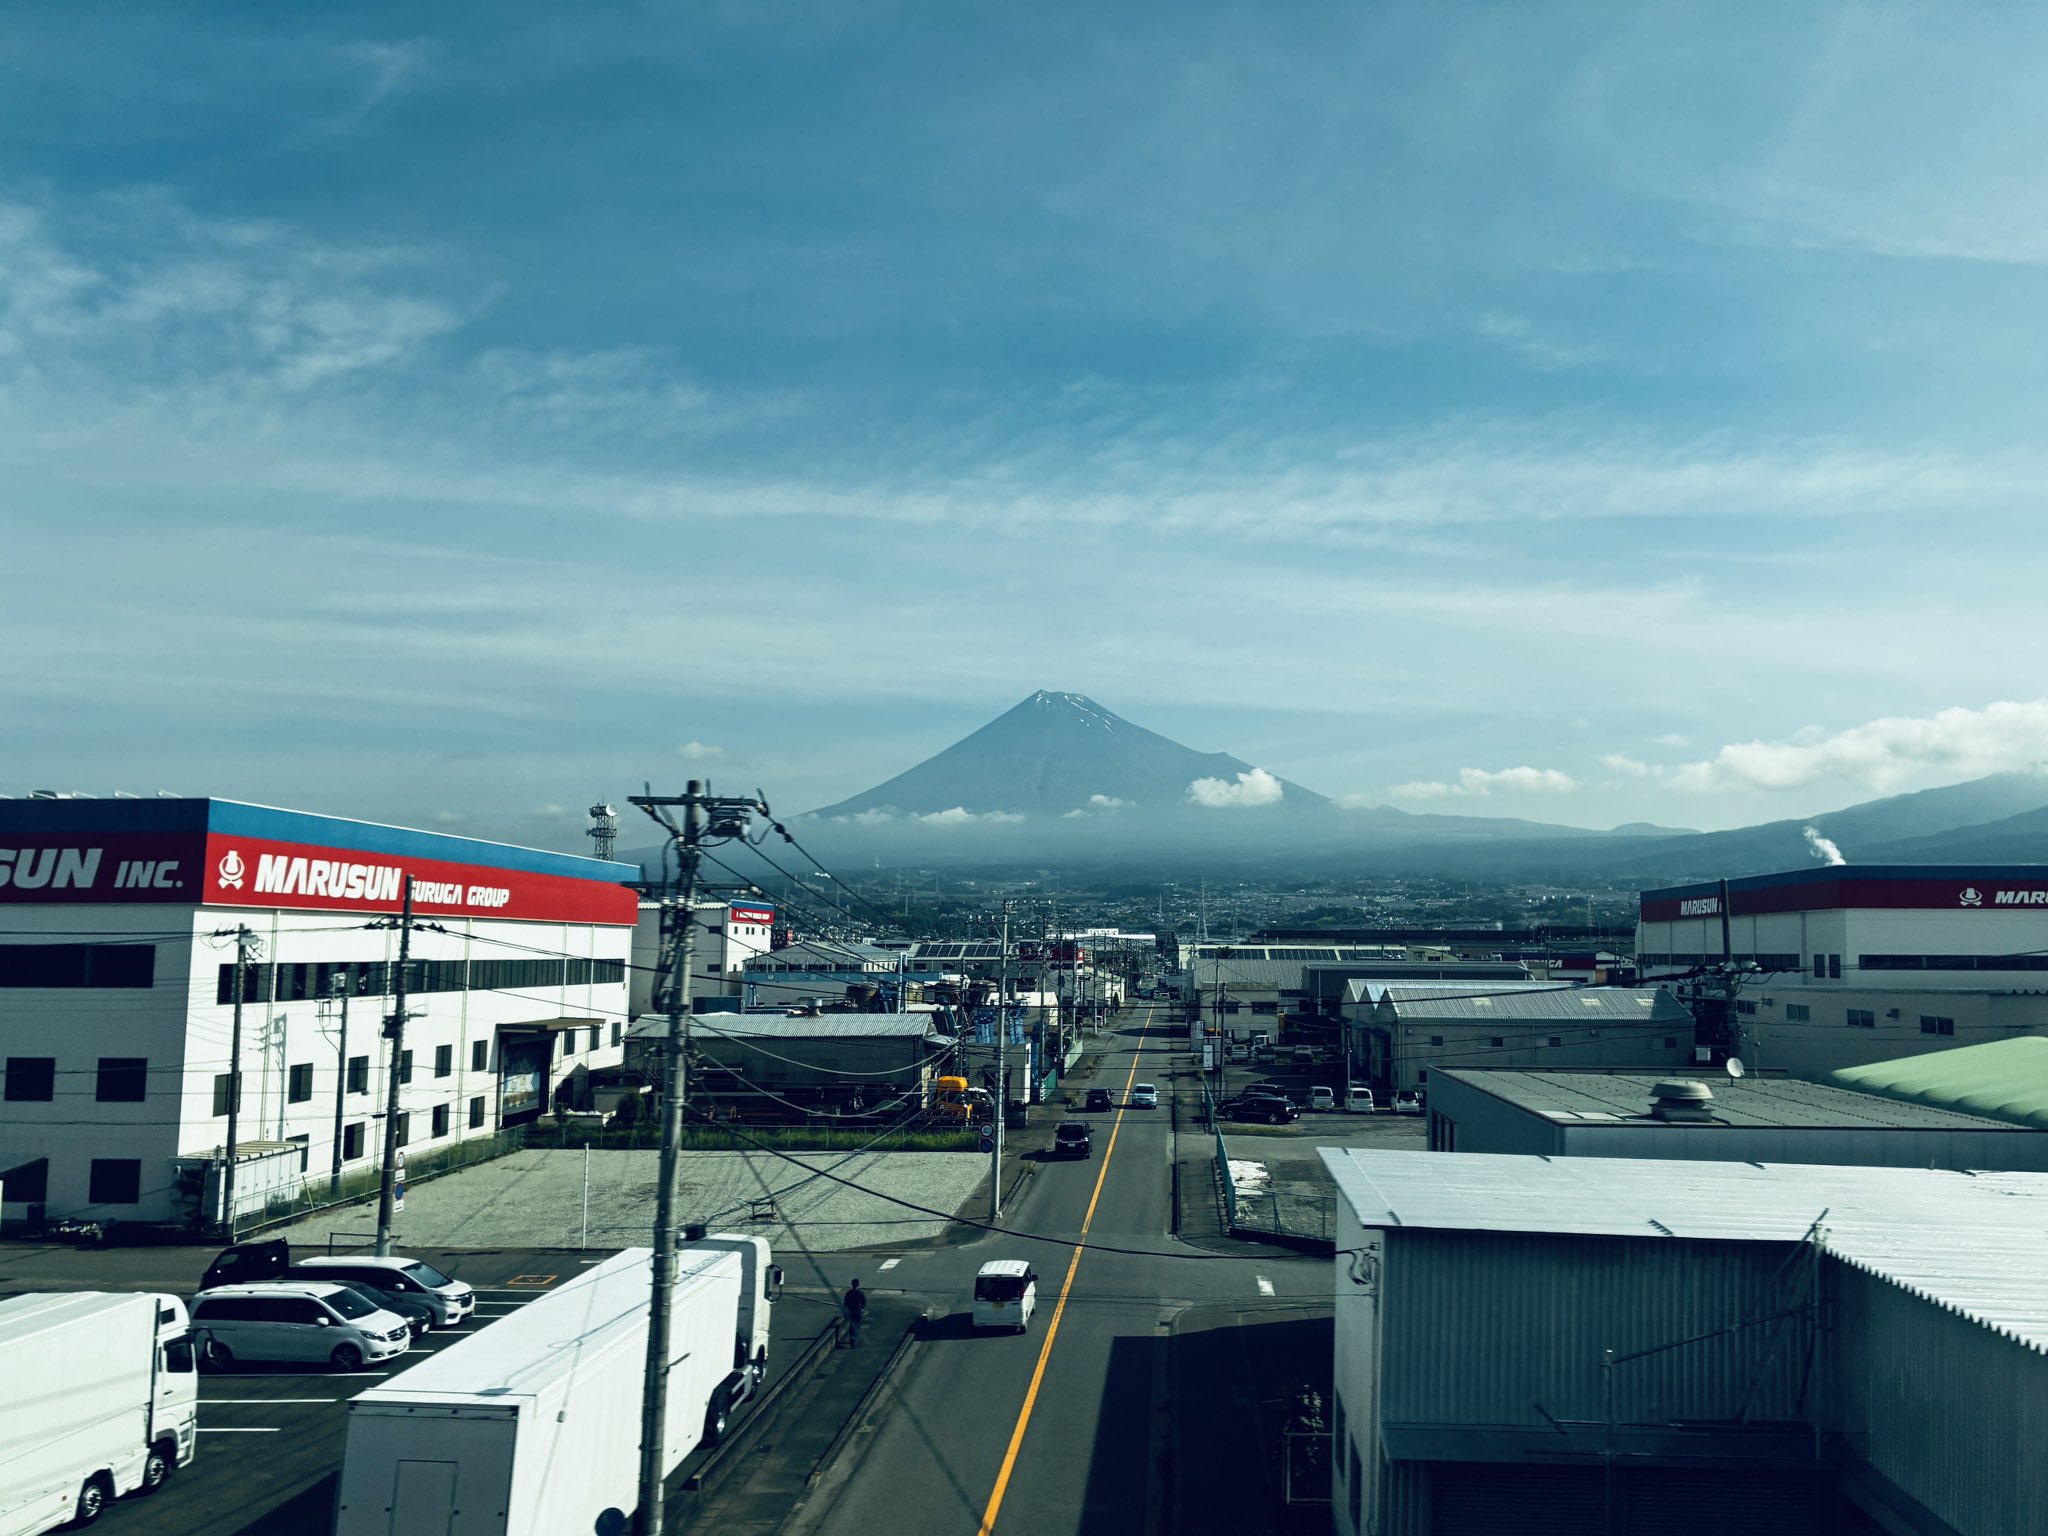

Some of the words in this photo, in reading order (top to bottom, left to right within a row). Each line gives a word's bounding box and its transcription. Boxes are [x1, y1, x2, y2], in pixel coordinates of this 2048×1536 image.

[113, 861, 183, 888] INC.
[254, 853, 402, 901] MARUSUN
[466, 885, 510, 908] GROUP
[1680, 897, 1718, 916] MARUSUN
[1994, 890, 2048, 904] MAR
